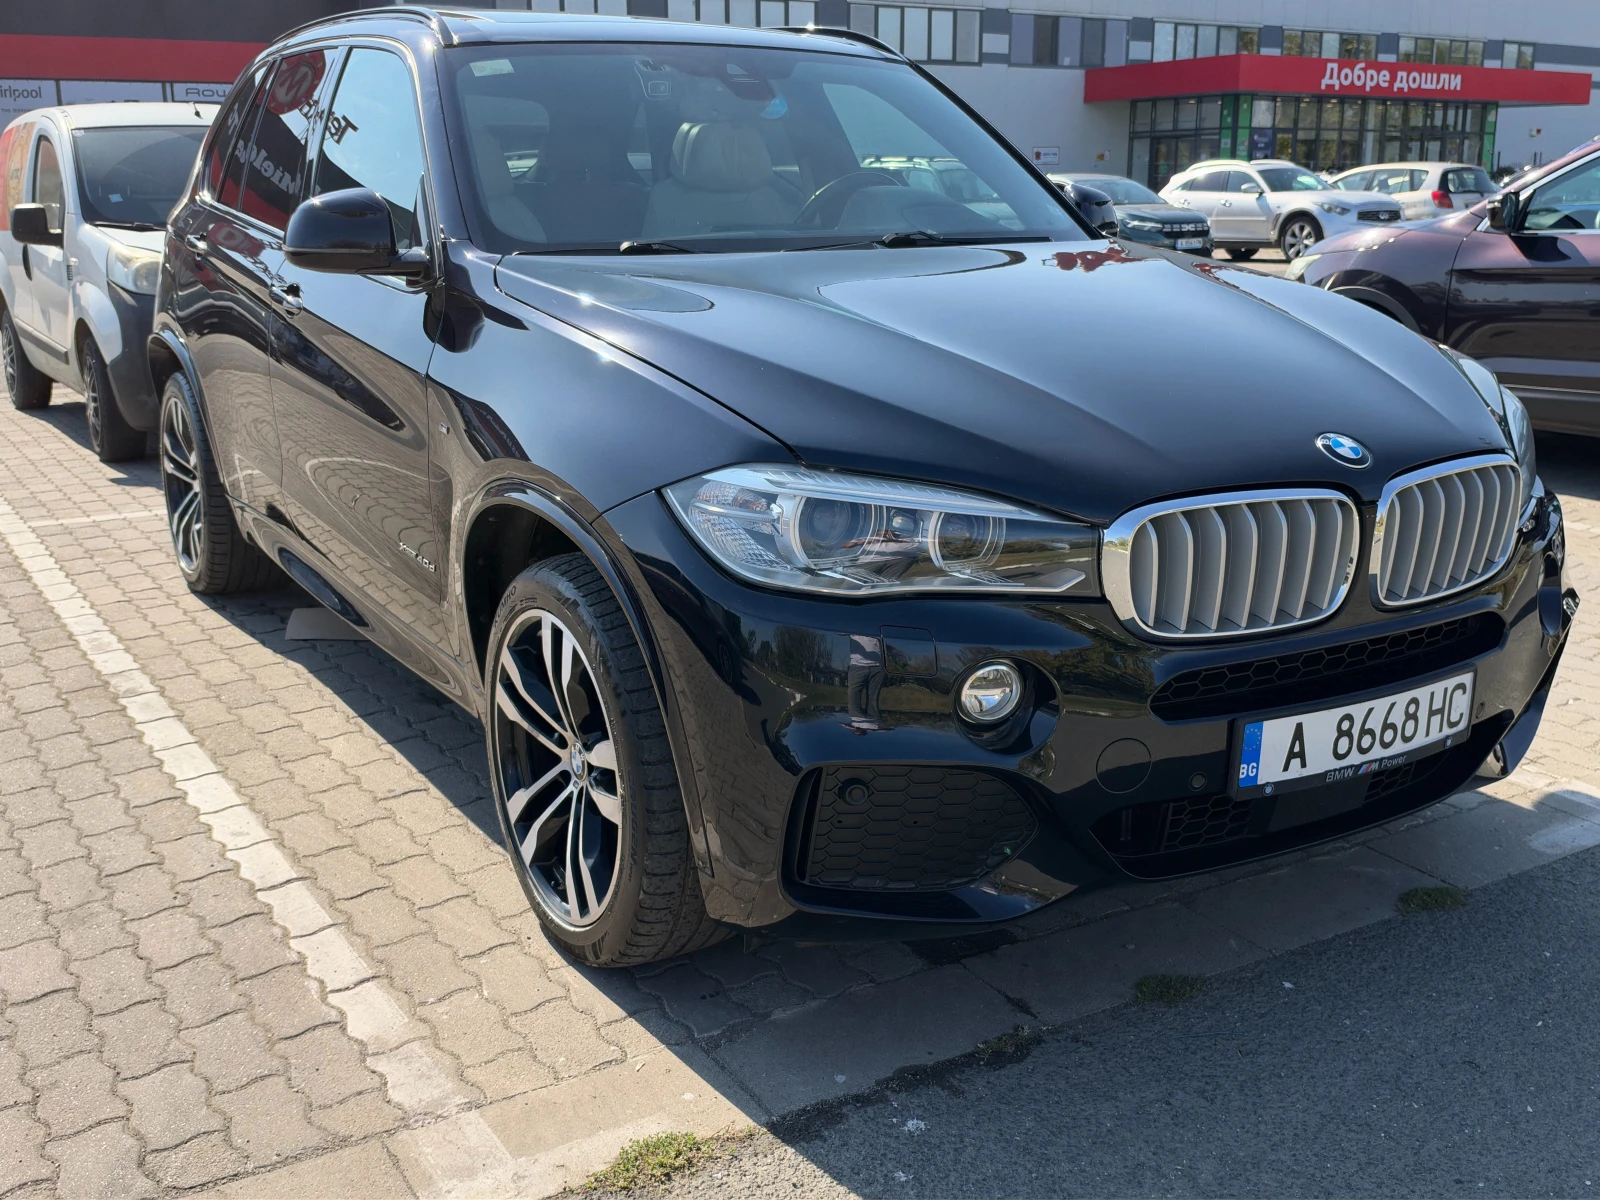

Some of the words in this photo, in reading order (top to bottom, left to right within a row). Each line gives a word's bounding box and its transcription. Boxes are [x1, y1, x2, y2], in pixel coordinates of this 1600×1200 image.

[1321, 62, 1390, 92] Добре
[1393, 71, 1461, 93] дошли
[1332, 696, 1420, 761] 8668
[1239, 763, 1258, 778] BG
[1326, 766, 1355, 782] BMW
[1381, 755, 1407, 768] Power
